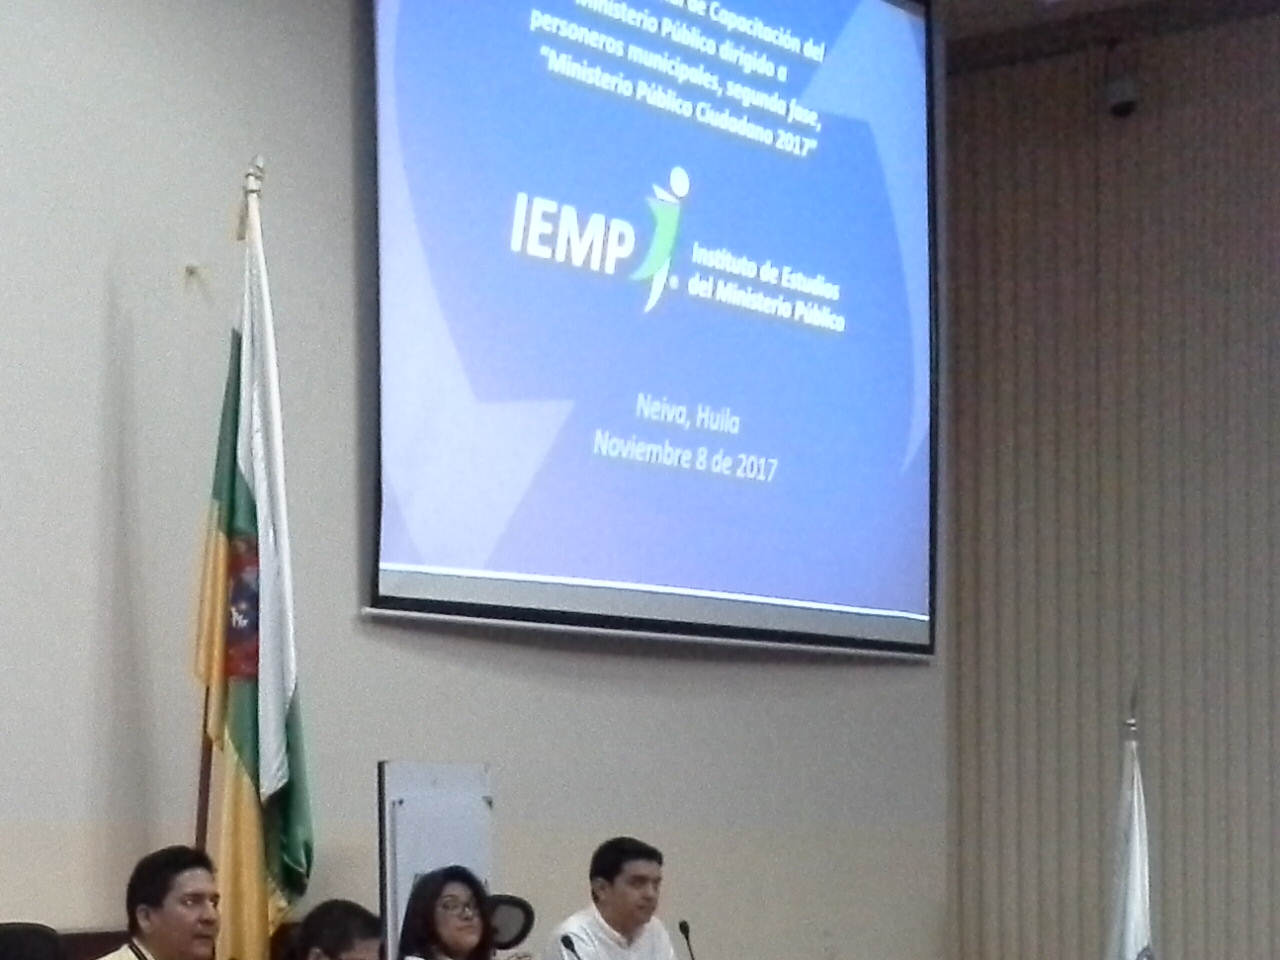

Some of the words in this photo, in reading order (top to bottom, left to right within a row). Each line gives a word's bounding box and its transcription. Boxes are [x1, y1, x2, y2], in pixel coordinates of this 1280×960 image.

[574, 0, 658, 33] inisterio
[660, 17, 717, 55] Público
[719, 40, 775, 77] dirigido
[777, 65, 789, 83] a
[709, 1, 802, 54] Capacitación
[803, 38, 826, 63] del
[530, 9, 624, 56] personeros
[627, 44, 723, 97] municipales,
[726, 79, 787, 116] segunda
[788, 98, 822, 132] fase,
[636, 79, 693, 117] Público
[695, 101, 774, 145] Ciudadano
[510, 192, 636, 275] IEMP
[692, 241, 757, 279] Instituto
[759, 260, 780, 284] de
[781, 265, 841, 300] Estudios
[687, 273, 713, 299] del
[715, 279, 792, 319] Ministerio
[794, 300, 846, 332] Público
[636, 393, 691, 430] Neiva,
[696, 404, 740, 434] Huila
[593, 429, 693, 469] Noviembre
[695, 446, 708, 471] 8
[711, 449, 733, 475] de
[736, 453, 779, 482] 2017
